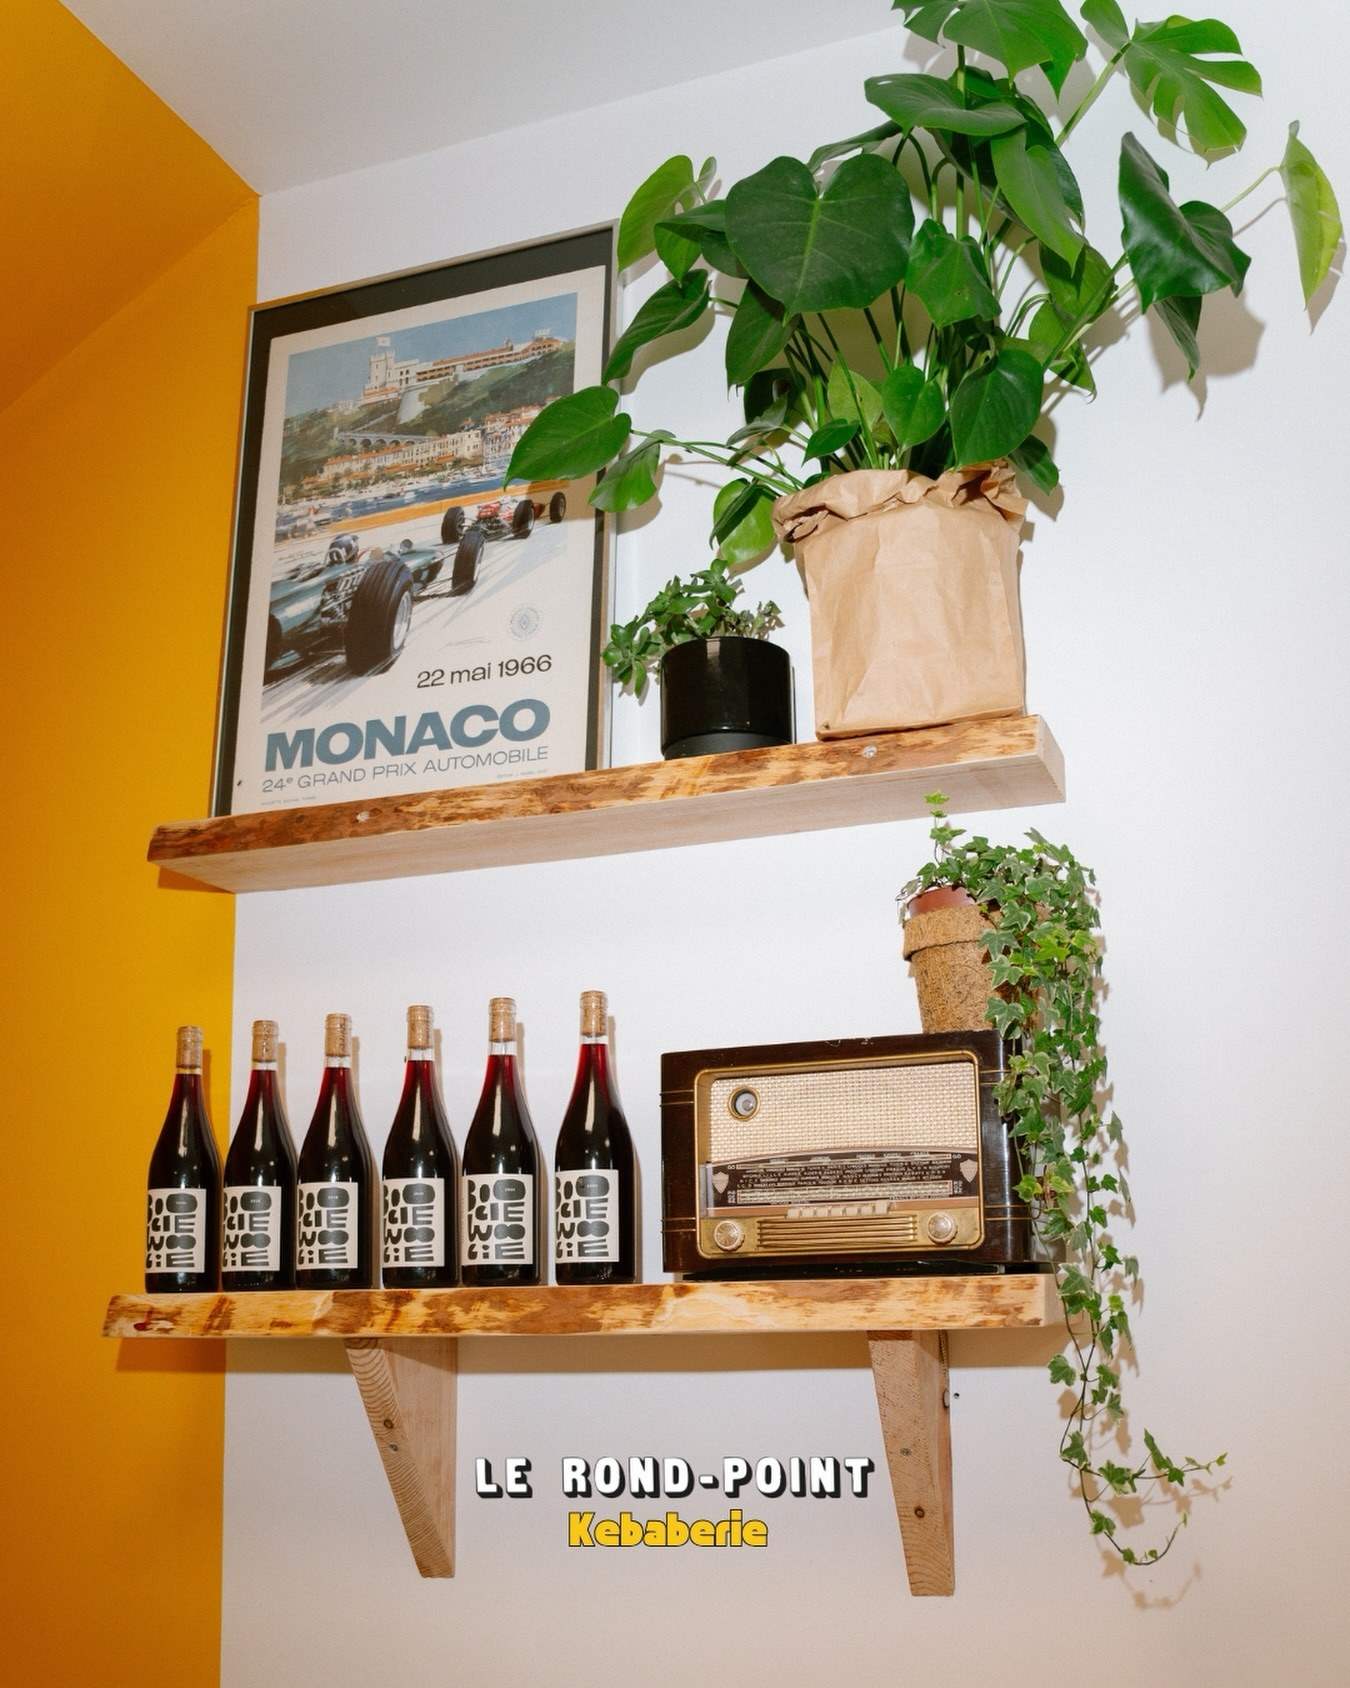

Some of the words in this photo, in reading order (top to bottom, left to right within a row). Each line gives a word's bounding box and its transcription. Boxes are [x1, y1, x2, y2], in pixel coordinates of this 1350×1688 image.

[416, 668, 445, 689] 22
[450, 662, 492, 685] mai
[498, 654, 553, 678] 1966
[265, 698, 550, 772] MONACO
[297, 768, 367, 789] GRAND
[373, 761, 418, 780] PRIX
[423, 746, 549, 773] AUTOMOBILE
